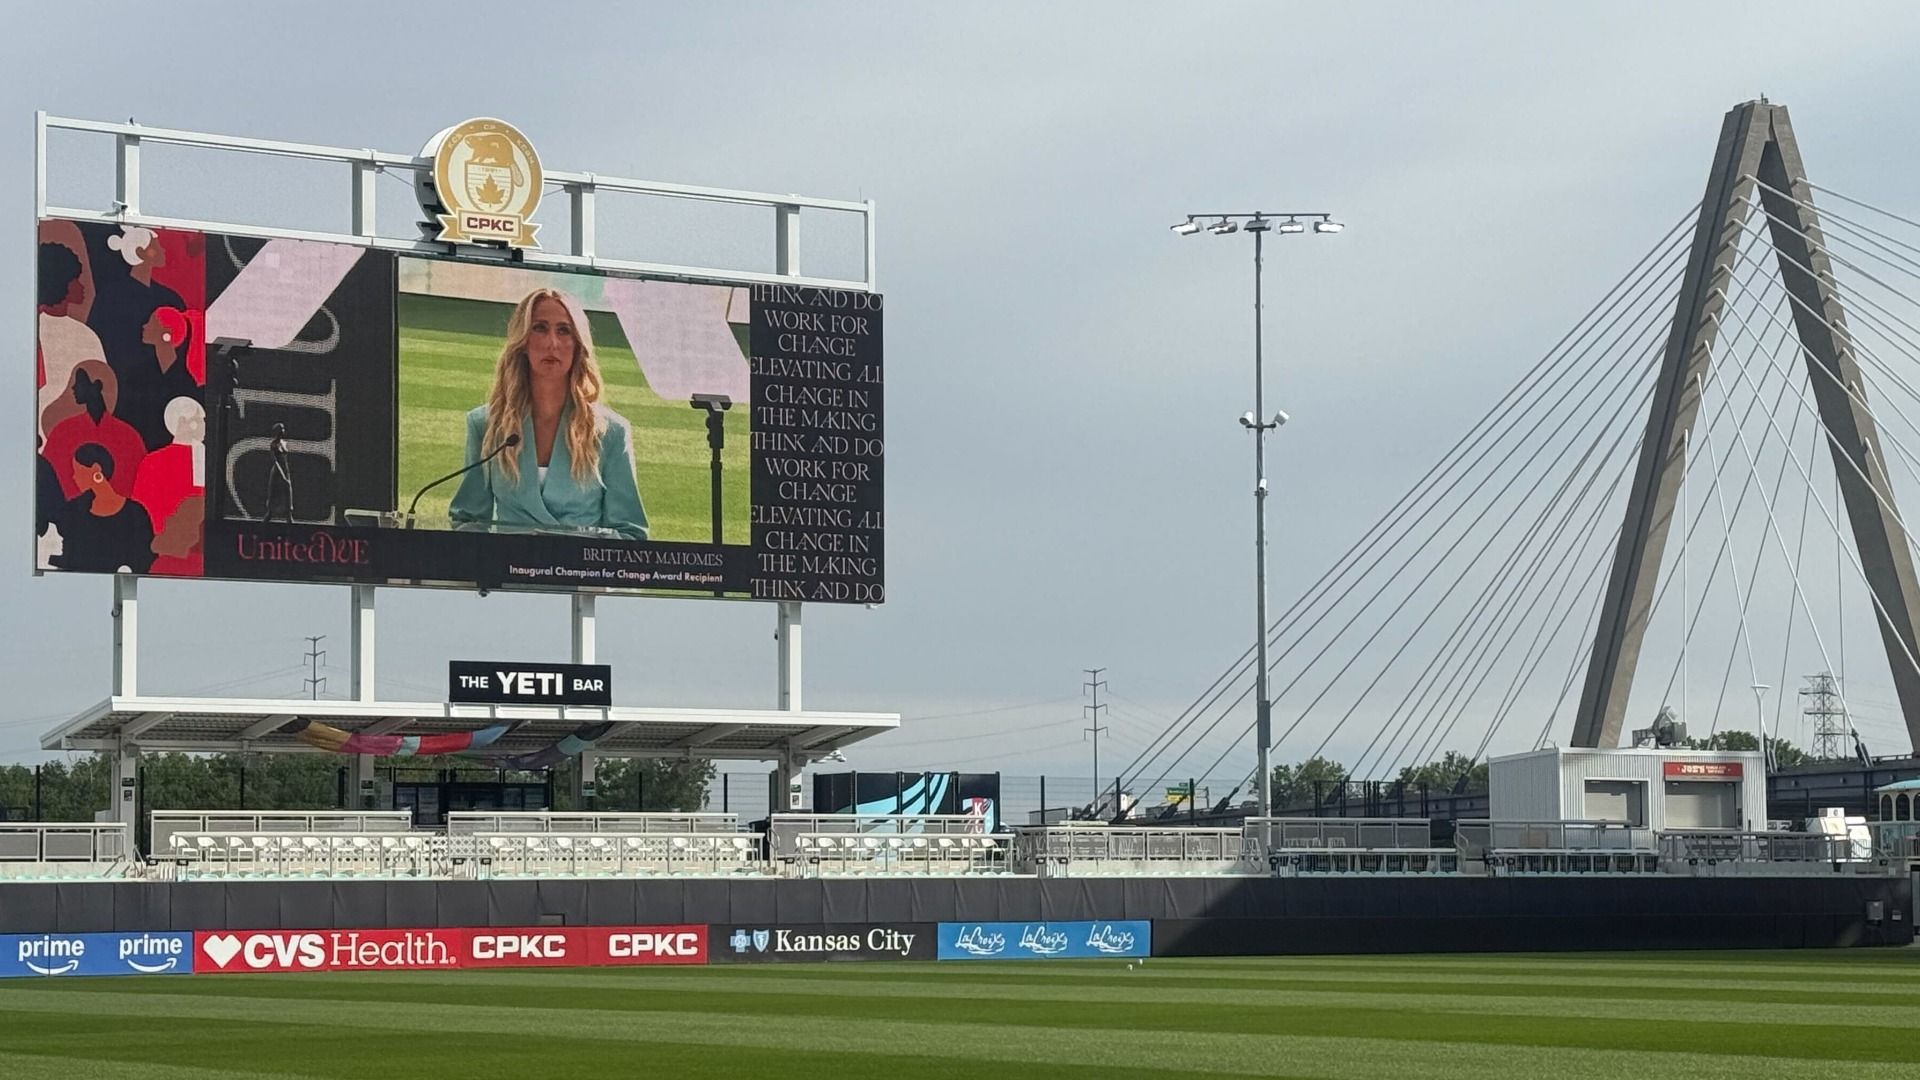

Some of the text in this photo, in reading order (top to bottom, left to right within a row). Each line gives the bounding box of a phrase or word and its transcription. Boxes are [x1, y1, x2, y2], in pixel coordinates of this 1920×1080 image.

[467, 216, 514, 232] CPKC
[753, 284, 883, 311] THINK AND DO
[764, 309, 869, 335] WORK FOR
[778, 333, 856, 357] CHANGE
[750, 356, 851, 381] ELEVATING
[765, 384, 868, 408] CHANGE IN
[757, 406, 876, 432] THE MAKING
[750, 431, 884, 457] THINK AND DO
[765, 457, 870, 481] WORK FOR
[779, 481, 857, 503] CHANGE
[750, 504, 852, 528] ELEVATING
[765, 531, 869, 553] CHANGE IN
[583, 547, 724, 567] BRITTANY MAHOMES
[758, 553, 876, 577] THE MAKING
[509, 564, 723, 585] Inaugural Champion for Change Award Recipient
[750, 578, 884, 601] THINK AND DO
[459, 671, 604, 696] THE YETI BAR
[18, 935, 85, 962] prime
[119, 933, 183, 960] prime
[243, 933, 326, 968] CVS
[472, 935, 566, 959] CPKC
[608, 933, 698, 957] CPKC
[775, 928, 916, 956] Kansas City
[955, 926, 1005, 954] LaCroix
[1019, 925, 1068, 954] LaCroix
[1086, 924, 1135, 953] LaCroix
